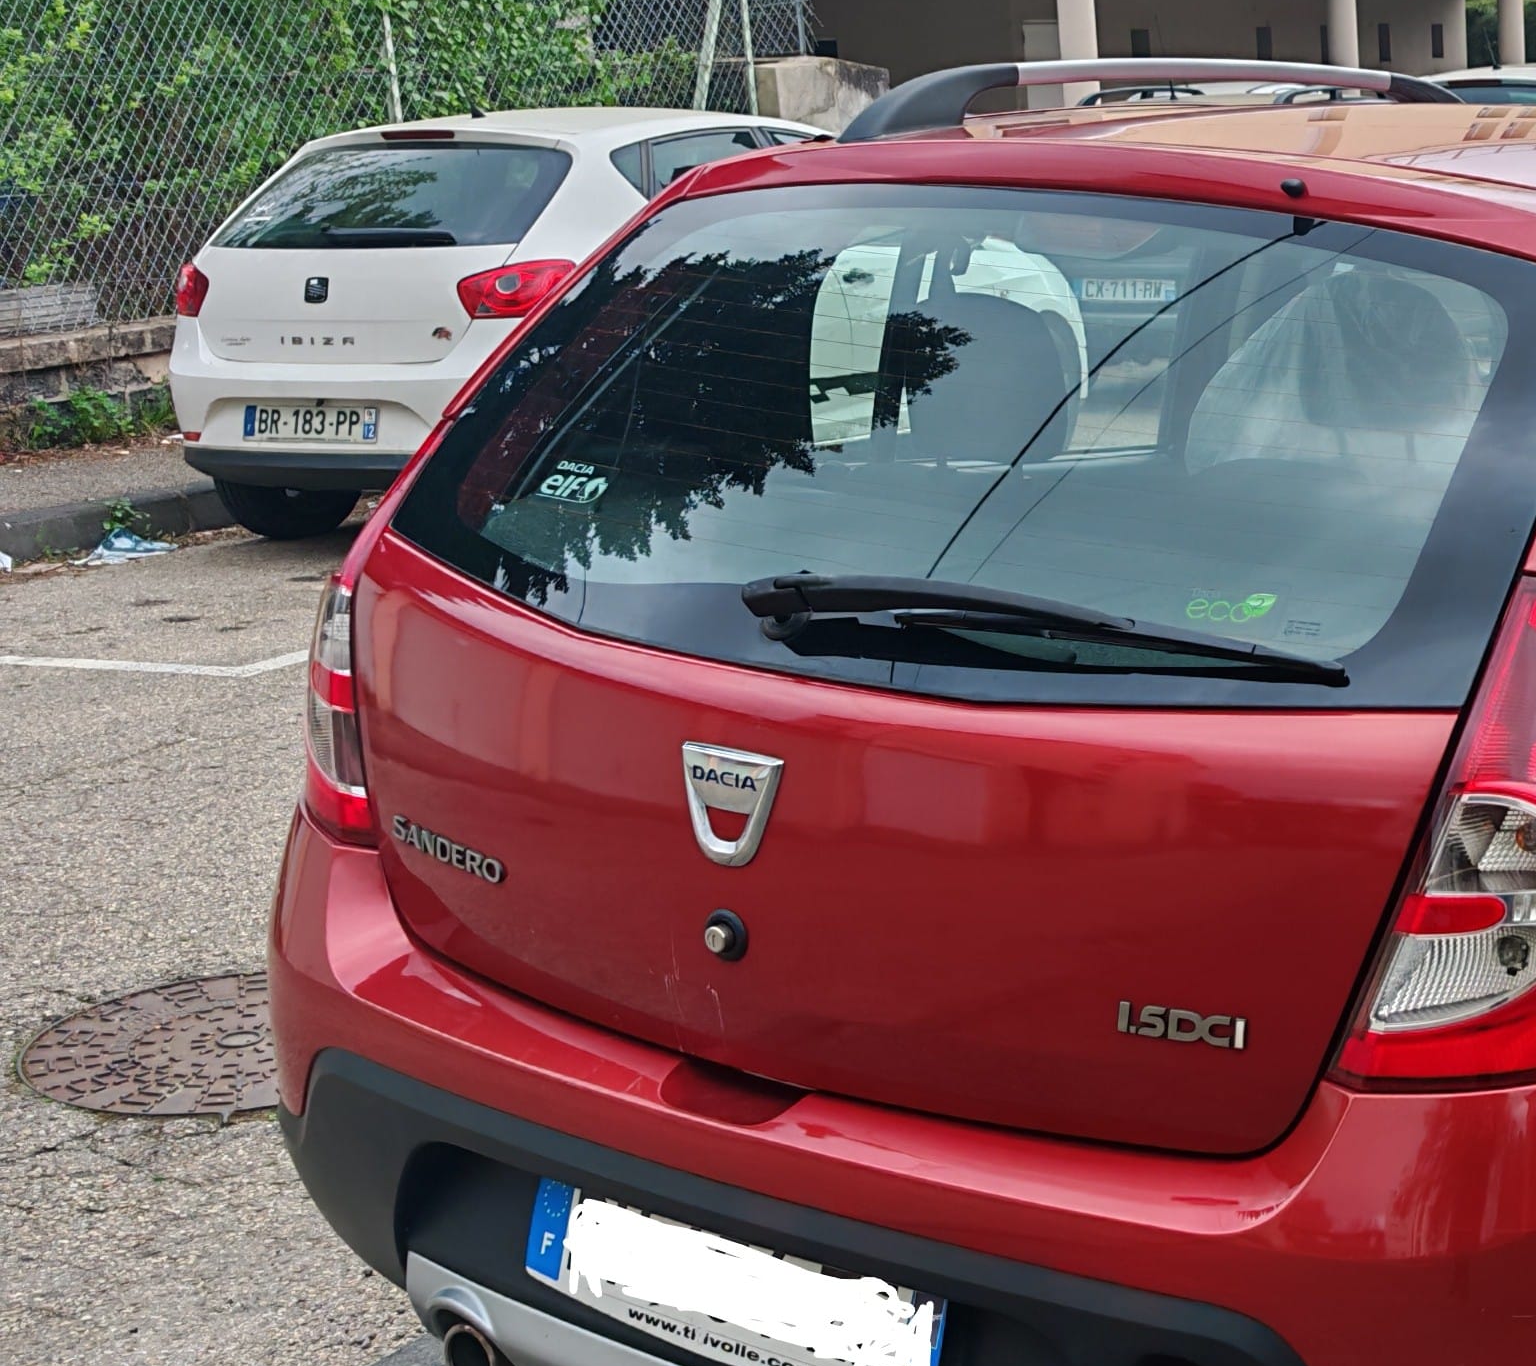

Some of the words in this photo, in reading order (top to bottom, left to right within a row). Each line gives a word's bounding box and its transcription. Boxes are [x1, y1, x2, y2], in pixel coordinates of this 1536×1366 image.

[280, 336, 355, 346] IBIZA
[258, 409, 361, 436] BR-183-PP
[557, 460, 595, 475] DACIA
[540, 475, 588, 497] elf
[692, 764, 757, 792] DACIA
[392, 814, 503, 884] SANDERO
[540, 1231, 555, 1256] F
